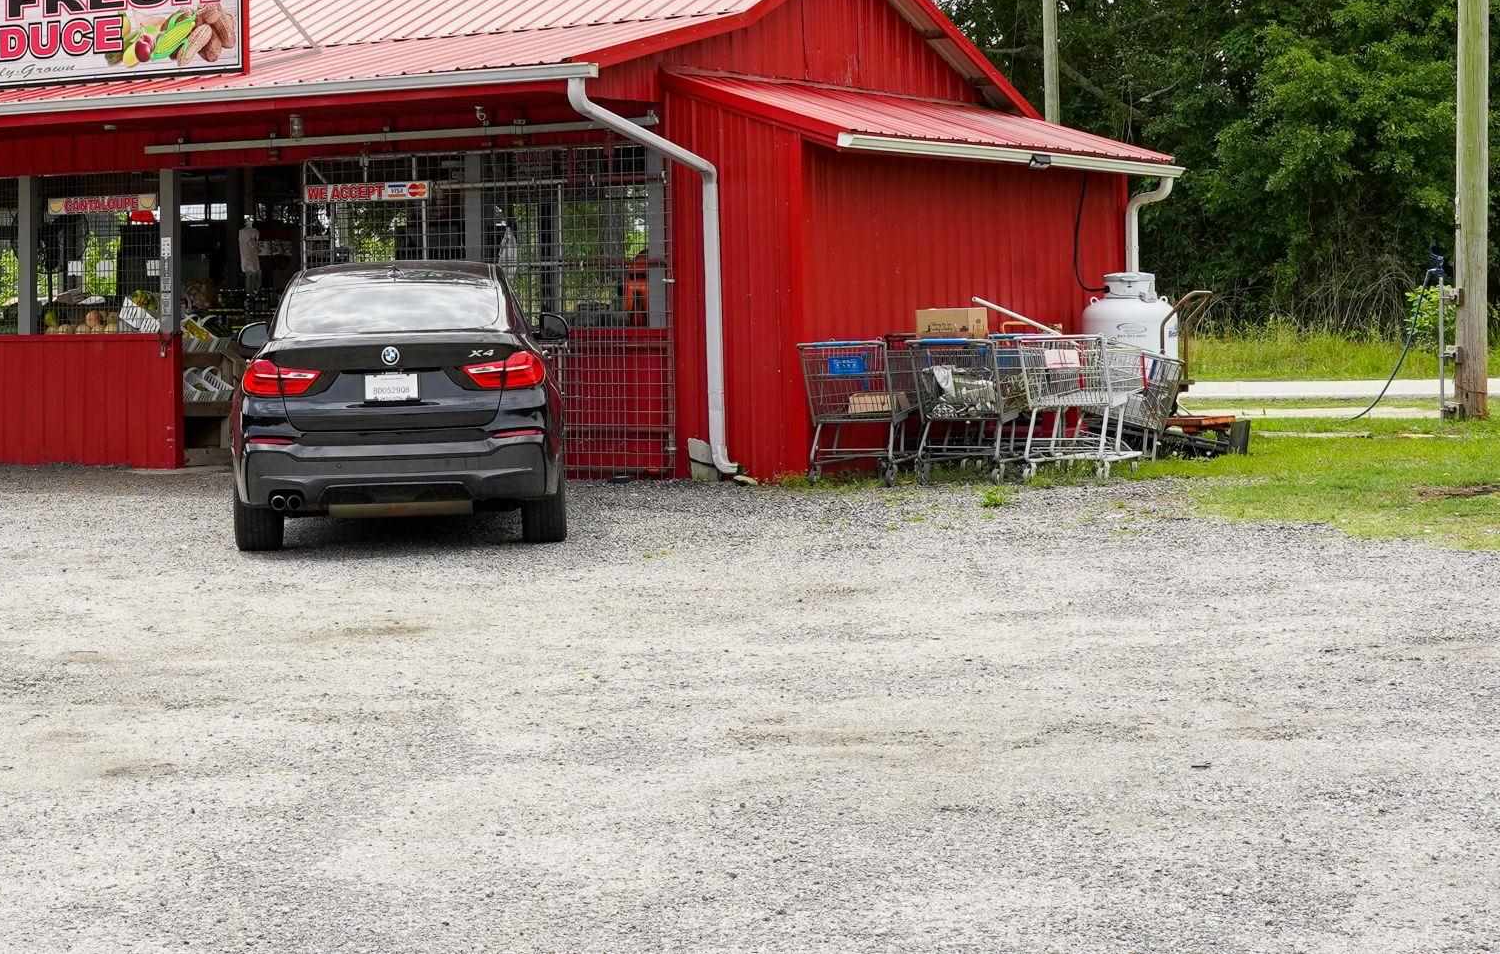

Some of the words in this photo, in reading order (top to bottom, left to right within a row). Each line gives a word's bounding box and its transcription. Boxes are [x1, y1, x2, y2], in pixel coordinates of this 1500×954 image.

[307, 185, 327, 199] WE
[331, 183, 385, 199] ACCEPT
[63, 198, 139, 213] CANTALOUPE
[468, 349, 494, 358] X4
